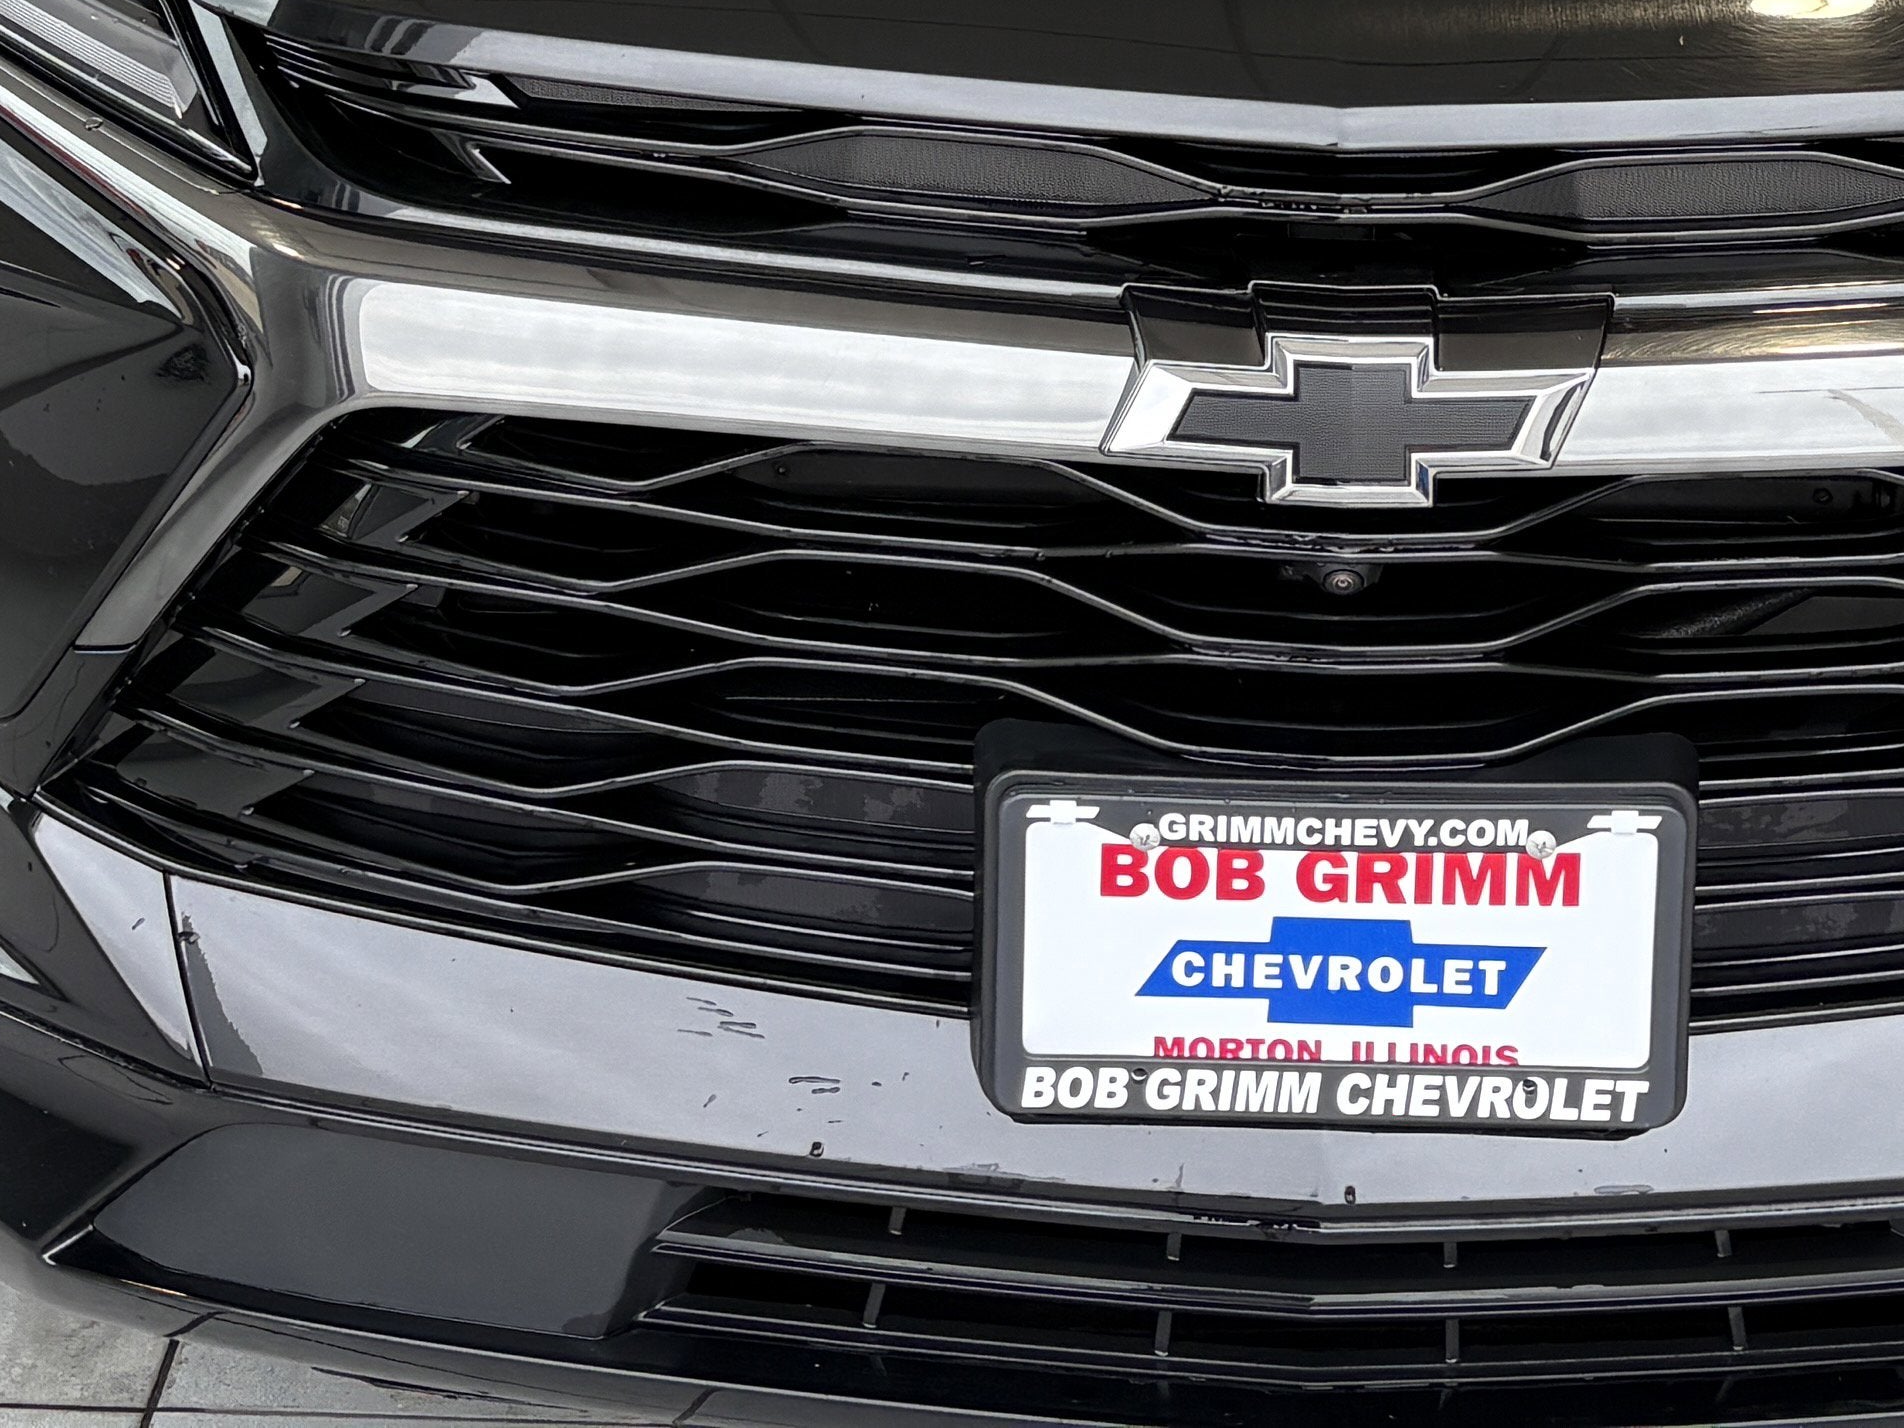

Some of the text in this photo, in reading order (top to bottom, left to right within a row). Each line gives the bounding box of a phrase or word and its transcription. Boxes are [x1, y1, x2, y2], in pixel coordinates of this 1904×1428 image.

[1158, 811, 1529, 848] GRIMMCHEVY.COM
[1100, 843, 1581, 907] BOB GRIMM
[1171, 950, 1507, 997] CHEVROLET
[1020, 1066, 1649, 1123] BOB GRIMM CHEVROLET
